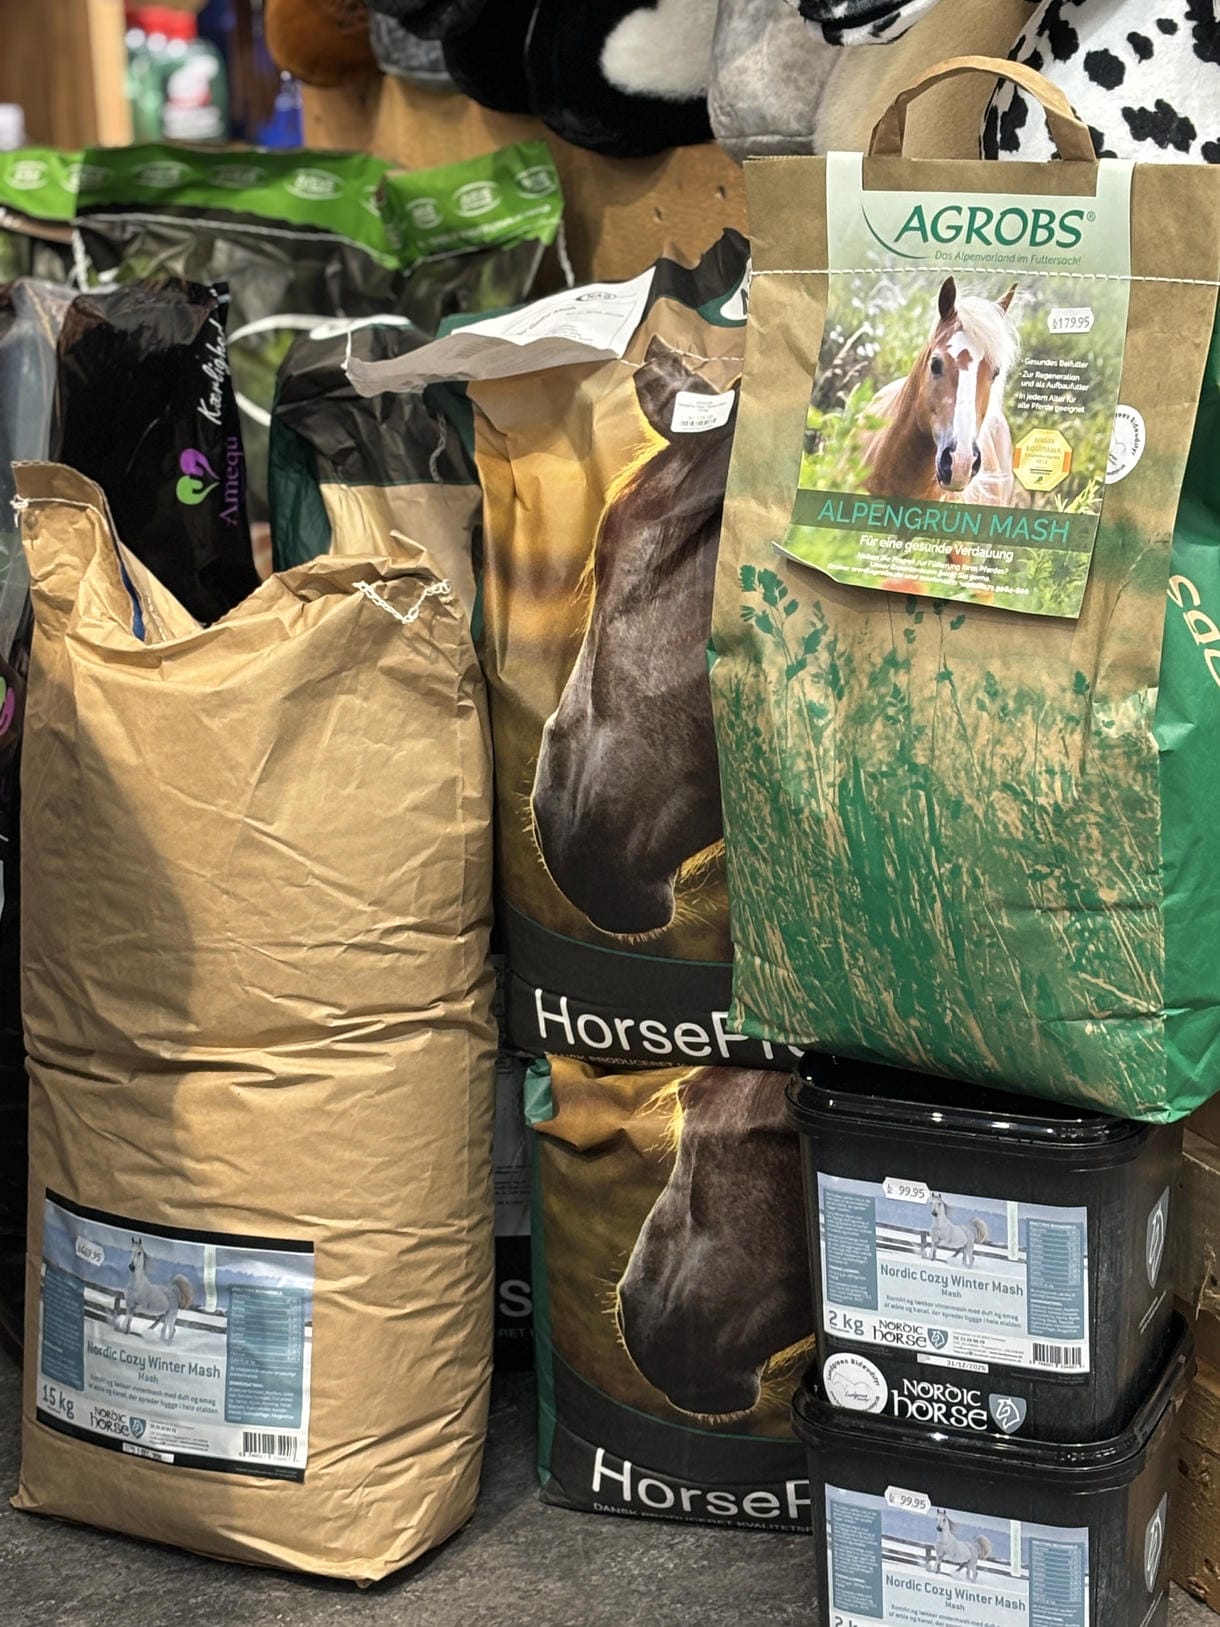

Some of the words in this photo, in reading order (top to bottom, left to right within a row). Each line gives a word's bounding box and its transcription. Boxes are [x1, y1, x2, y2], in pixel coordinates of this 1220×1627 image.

[935, 250, 952, 261] Das
[954, 251, 1015, 264] Alpenvorland
[1016, 253, 1028, 263] im
[1030, 254, 1081, 266] Futtersack!
[1022, 370, 1034, 378] Zur
[1035, 372, 1080, 381] Regeneration
[1021, 380, 1034, 388] und
[1046, 382, 1089, 391] Aufbaufutter
[1026, 393, 1048, 402] jedem
[1049, 394, 1065, 402] Alter
[1031, 403, 1054, 411] Pferde
[817, 498, 982, 536] ALPENGRÜN
[989, 514, 1070, 543] MASH
[859, 534, 877, 547] Für
[879, 537, 903, 549] eine
[904, 541, 952, 554] gesunde
[953, 544, 1014, 563] Verdauung
[899, 1186, 925, 1199] 99.95
[880, 1263, 918, 1280] Nordic
[920, 1270, 948, 1288] Cozy
[951, 1274, 990, 1291] Winter
[992, 1280, 1024, 1296] Mash
[941, 1288, 962, 1298] Mash
[828, 1310, 837, 1327] 2
[843, 1313, 864, 1336] kg
[87, 1340, 117, 1360] Nordic
[120, 1349, 146, 1371] Cozy
[148, 1355, 186, 1374] Winter
[188, 1362, 220, 1379] Mash
[138, 1371, 158, 1384] Mash
[42, 1383, 56, 1402] 15
[58, 1391, 75, 1420] kg
[901, 1495, 926, 1510] 99.95
[886, 1574, 921, 1592] Nordic
[924, 1582, 951, 1601] Cozy
[955, 1587, 992, 1605] Winter
[995, 1595, 1026, 1611] Mash
[945, 1601, 965, 1611] Mash
